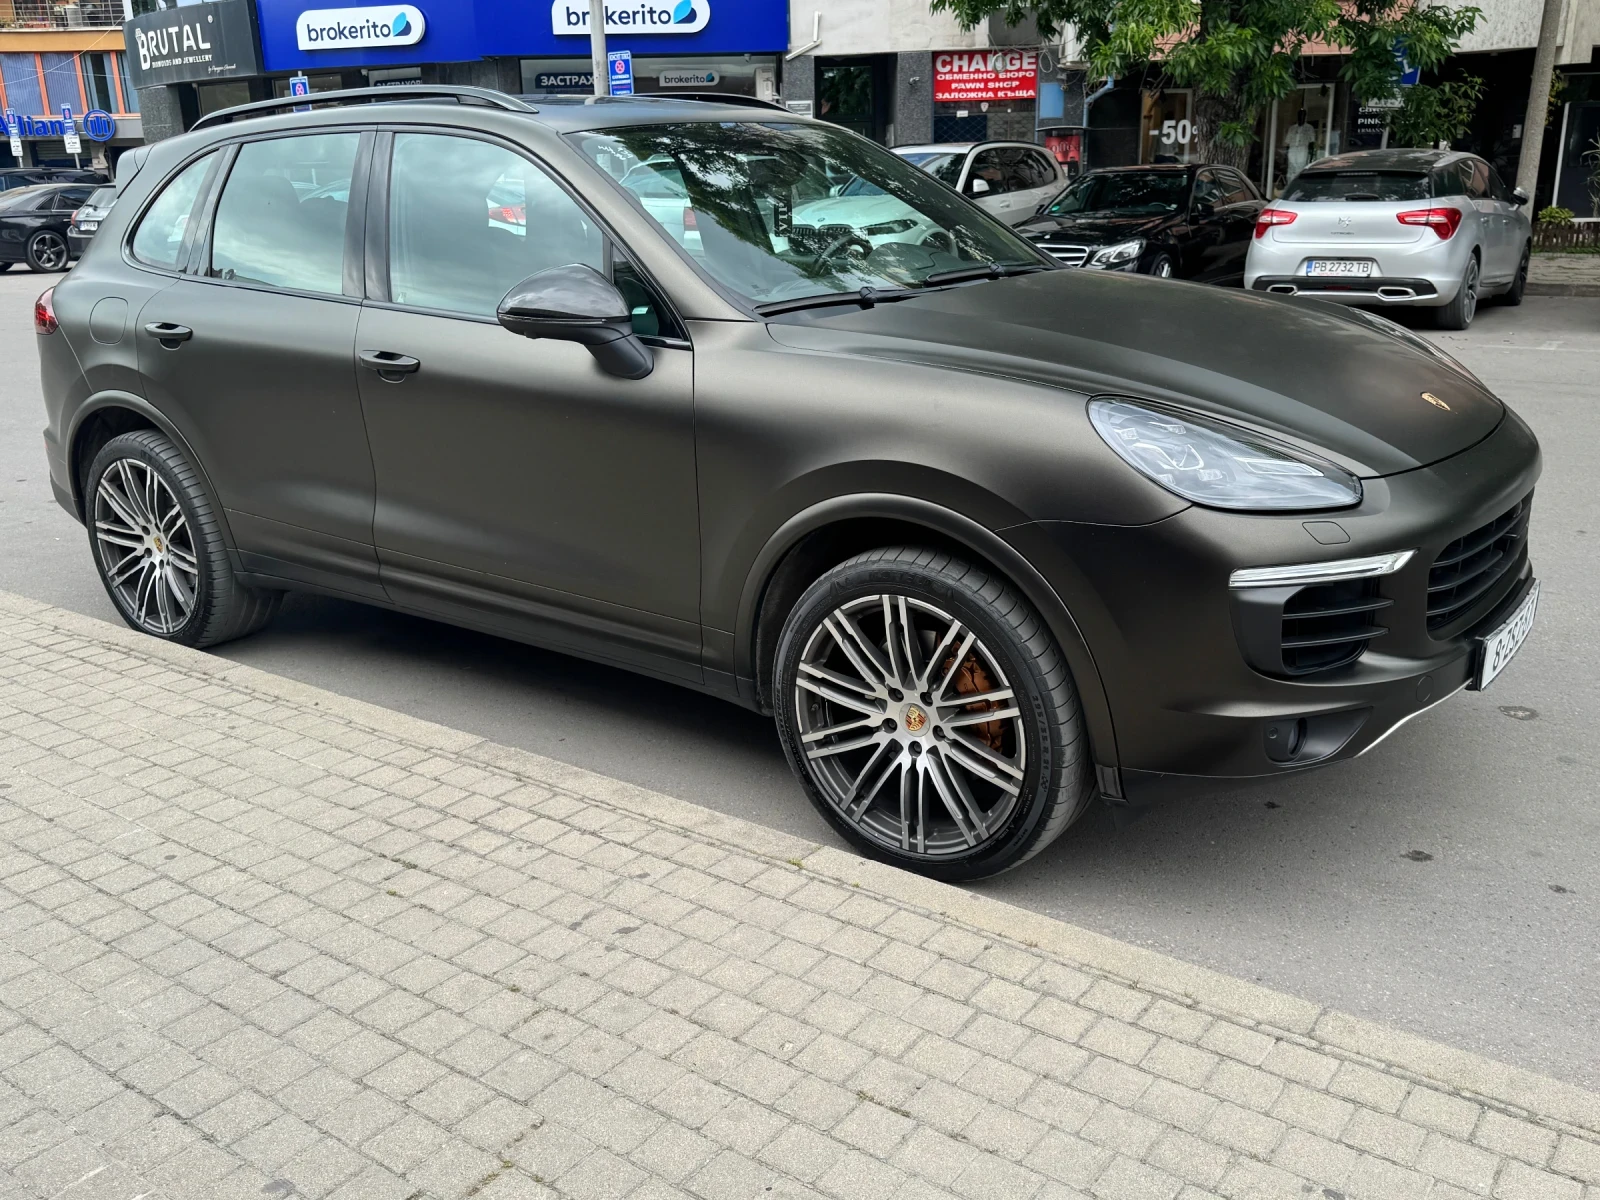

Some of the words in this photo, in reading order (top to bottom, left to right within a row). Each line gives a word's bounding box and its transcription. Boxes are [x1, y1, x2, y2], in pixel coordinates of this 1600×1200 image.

[566, 4, 671, 26] brkerito
[307, 19, 391, 42] brokerito
[137, 23, 211, 71] BRUTAL
[172, 57, 182, 66] AND
[183, 54, 213, 64] JEWELLERY
[936, 52, 1036, 73] CHANGE
[540, 75, 595, 86] ЗАСТРАХ
[664, 73, 705, 84] brokerito
[937, 72, 996, 81] ОБМЕННО
[998, 71, 1035, 79] БЮРО
[951, 82, 985, 90] PAWN
[987, 81, 1020, 89] SHOP
[935, 91, 995, 99] ЗАЛОЖНА
[997, 90, 1036, 98] КЪЩА
[1313, 261, 1327, 272] PB
[1328, 261, 1354, 273] 2732
[1356, 262, 1369, 273] TB
